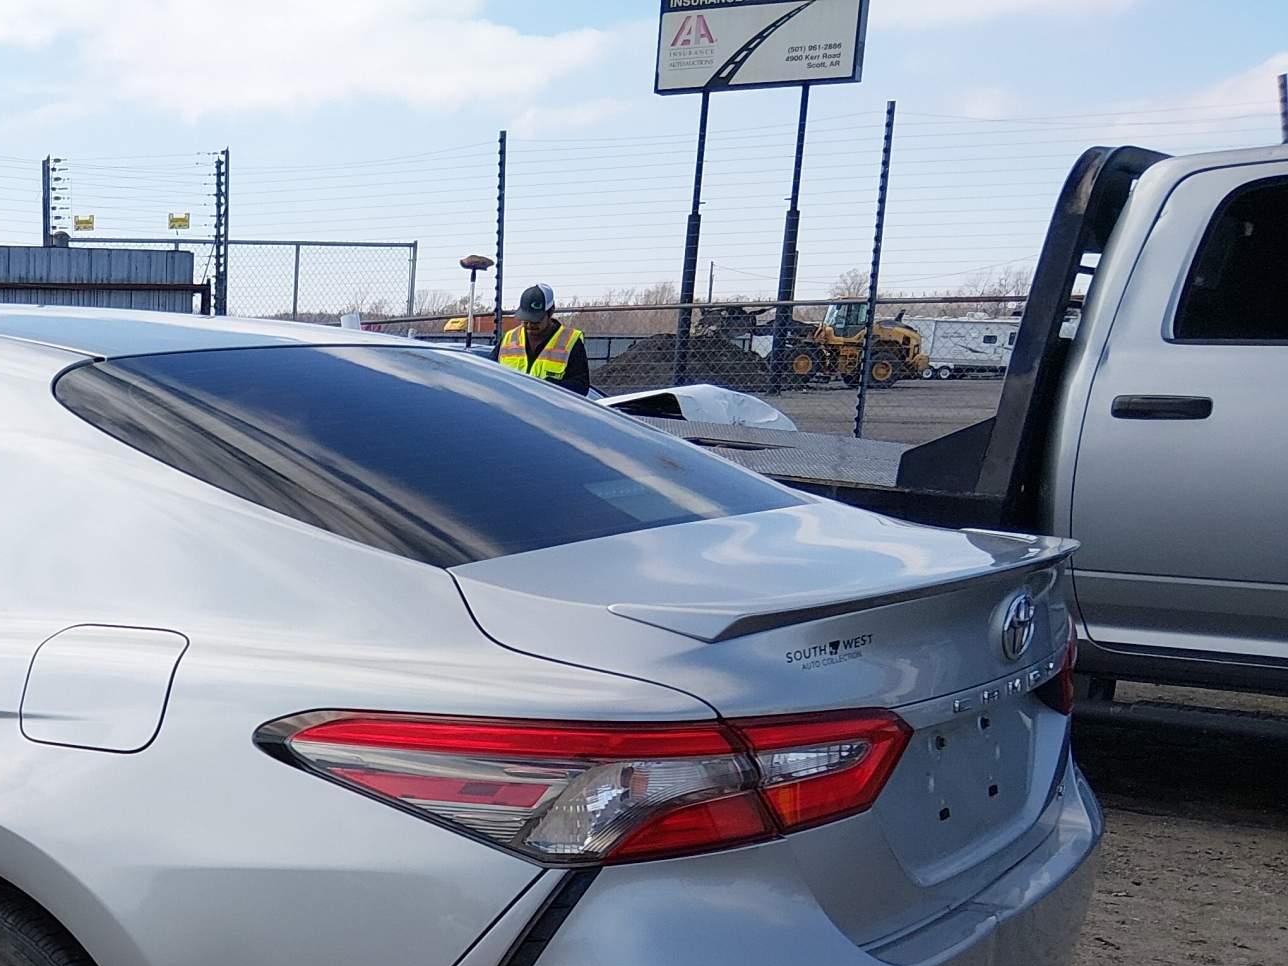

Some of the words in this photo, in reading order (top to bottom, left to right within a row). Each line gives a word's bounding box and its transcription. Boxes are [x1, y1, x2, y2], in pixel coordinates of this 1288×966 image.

[805, 53, 820, 61] Kerr
[785, 645, 827, 663] SOUTH
[842, 634, 873, 650] WEST
[802, 660, 821, 670] AUTO
[822, 651, 863, 666] COLLECTION
